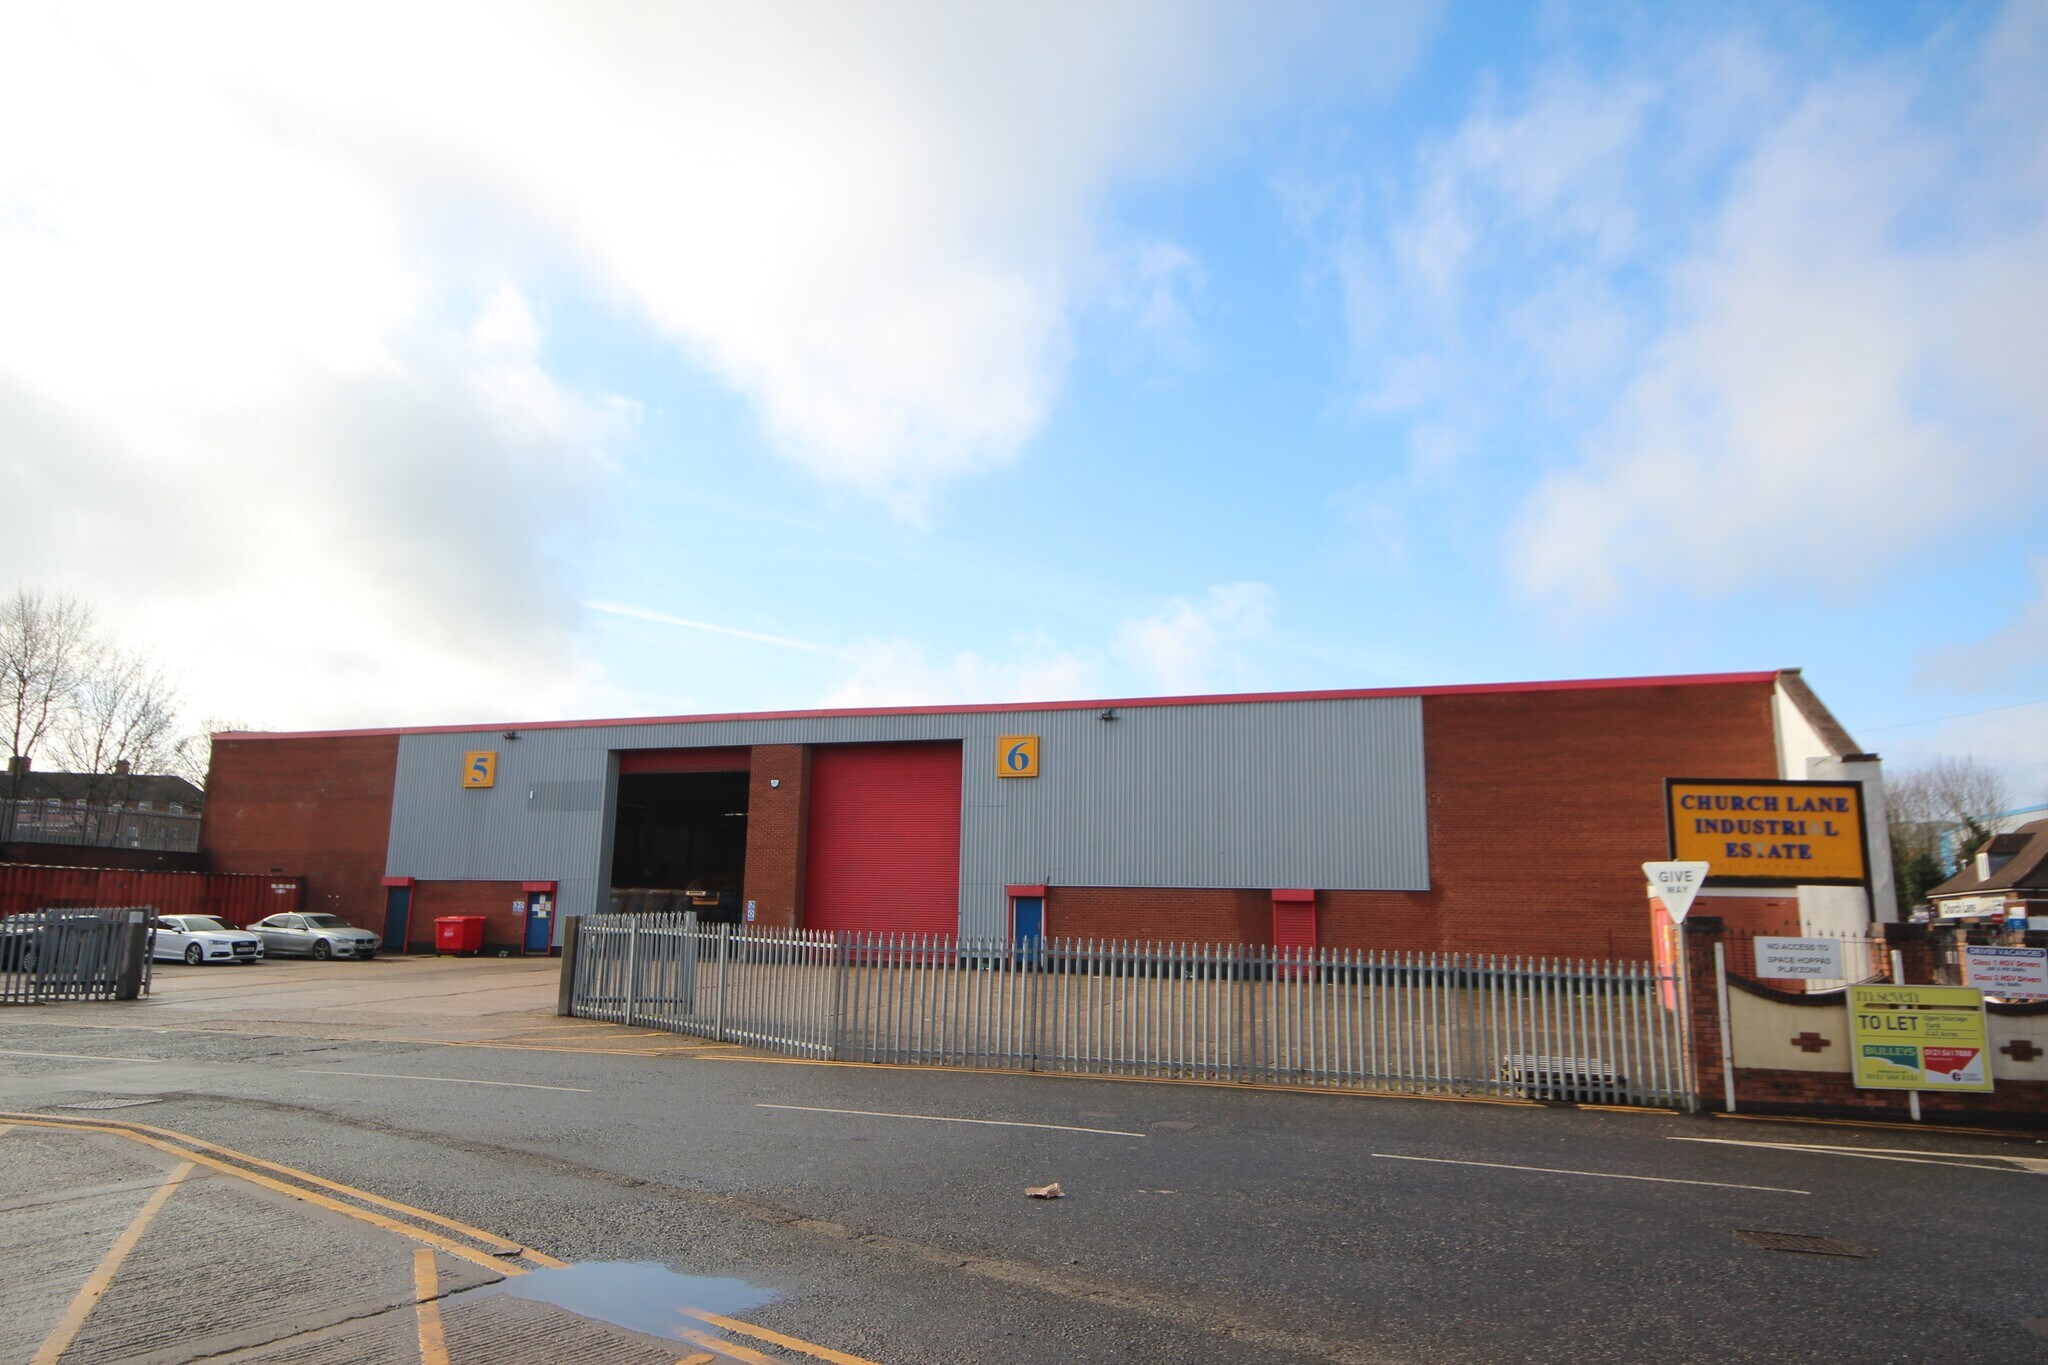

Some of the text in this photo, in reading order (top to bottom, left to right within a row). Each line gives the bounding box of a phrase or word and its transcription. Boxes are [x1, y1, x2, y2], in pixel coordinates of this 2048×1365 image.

[1008, 742, 1030, 771] 6
[472, 758, 488, 782] 5
[1681, 794, 1849, 812] CHURCH LANE
[1659, 870, 1693, 882] GIVE
[1667, 885, 1688, 893] WAY
[1781, 943, 1816, 951] ACCESS
[1970, 947, 2043, 957] DRIVER VACANCIES
[2000, 959, 2015, 967] HGV
[2016, 960, 2041, 968] Drivers
[1778, 965, 1822, 974] PLAYZONE
[1974, 973, 1993, 981] Class
[2000, 974, 2016, 982] HGV
[2018, 975, 2042, 983] Drivers
[1877, 991, 1920, 1003] seven
[1858, 1014, 1918, 1031] TO LET
[1865, 1046, 1917, 1056] BULLEYS
